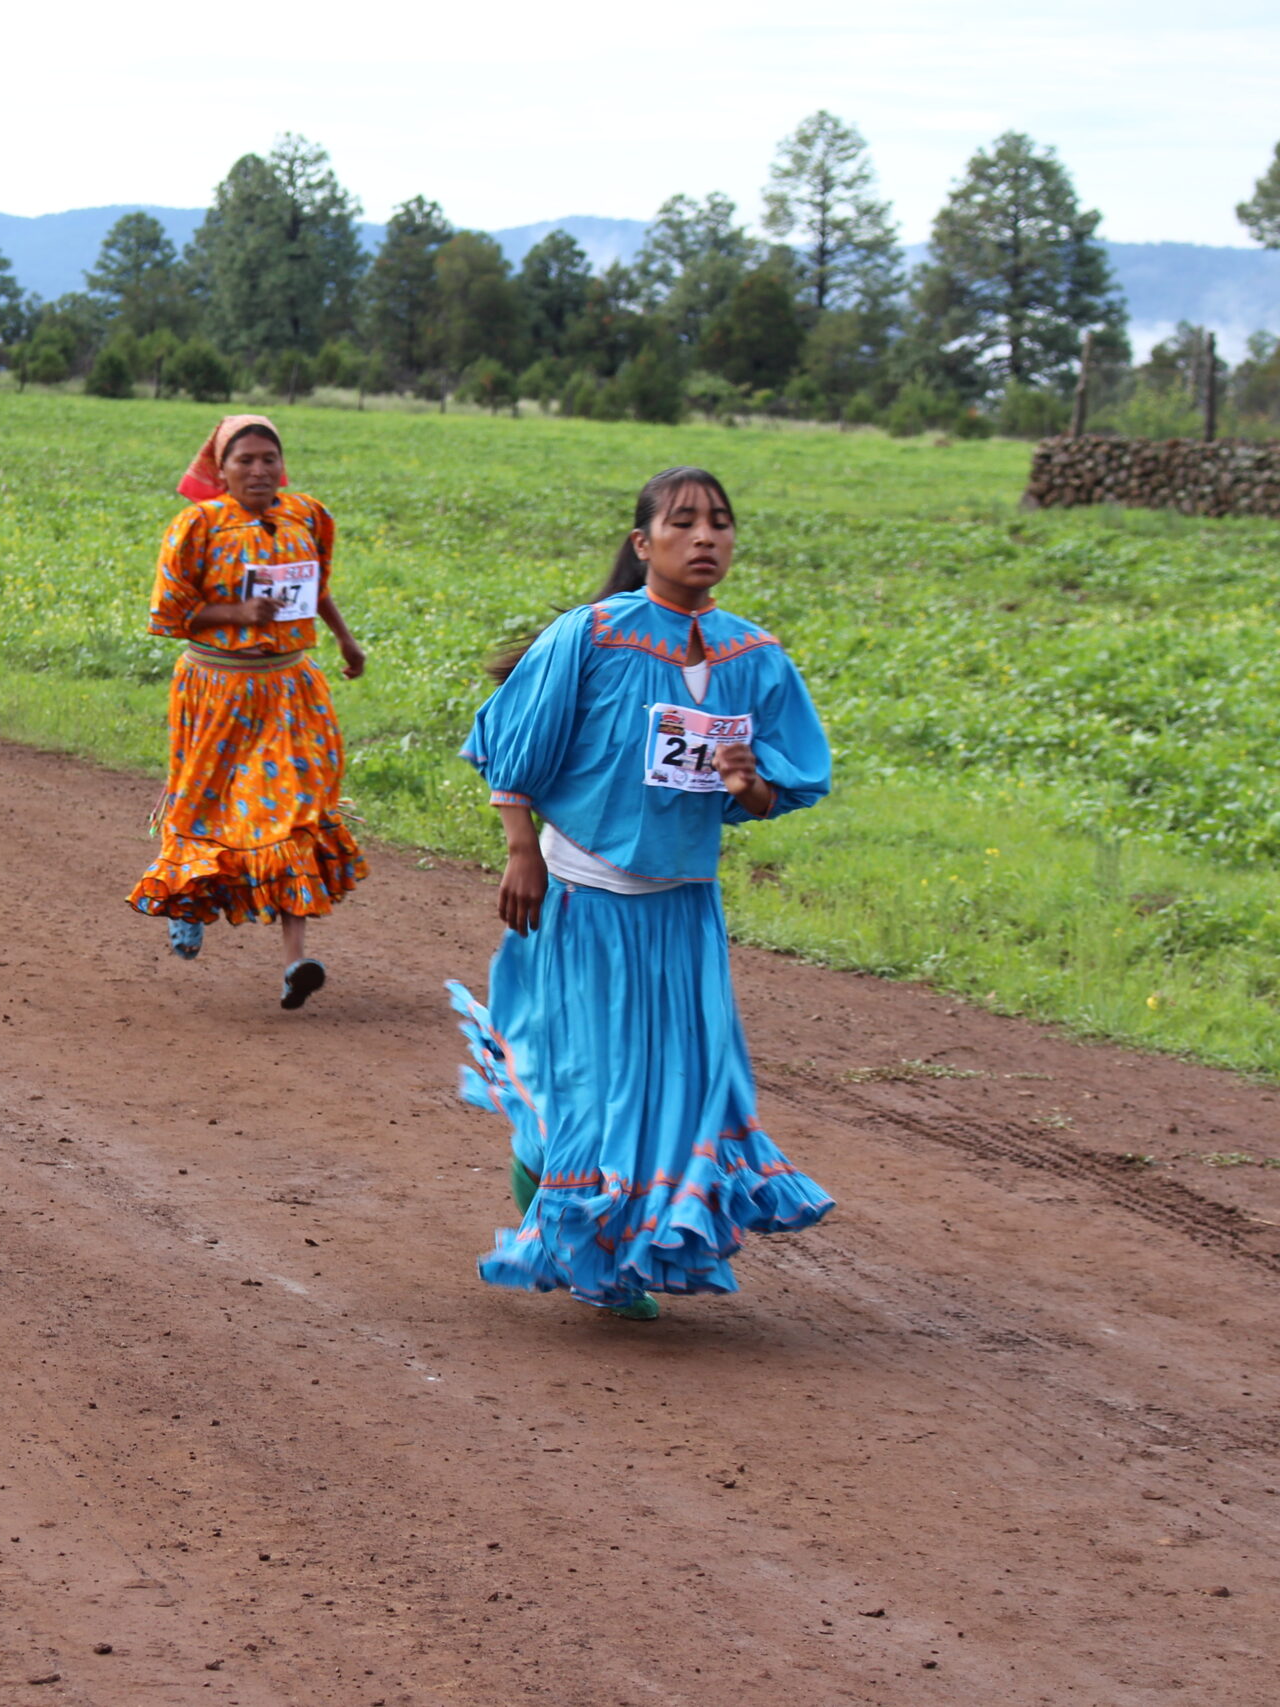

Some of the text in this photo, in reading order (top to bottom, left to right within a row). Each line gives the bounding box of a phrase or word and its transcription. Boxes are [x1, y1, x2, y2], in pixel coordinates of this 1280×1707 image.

[707, 720, 734, 736] 21
[733, 720, 748, 736] K
[662, 737, 717, 771] 21
